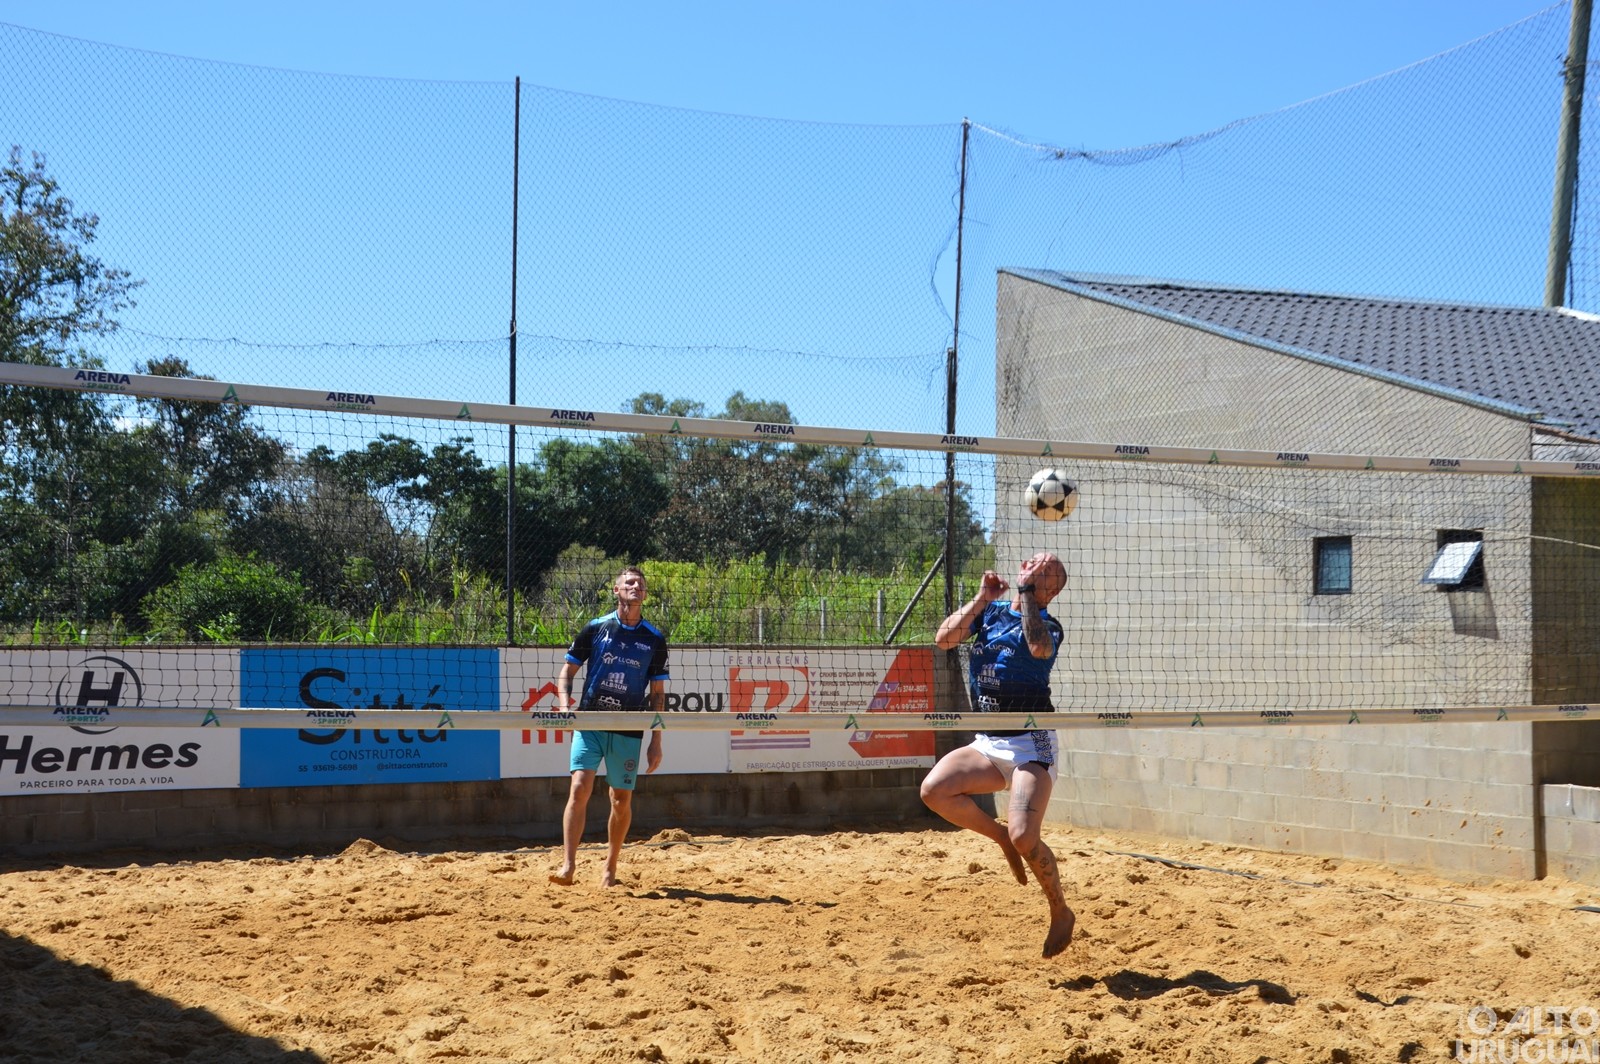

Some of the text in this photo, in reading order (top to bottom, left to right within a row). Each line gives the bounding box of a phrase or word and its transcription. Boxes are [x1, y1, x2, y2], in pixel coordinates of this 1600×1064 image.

[74, 370, 131, 385] ARENA
[325, 391, 376, 405] ARENA
[550, 409, 595, 421] ARENA
[754, 424, 795, 435] ARENA
[941, 435, 979, 446] ARENA
[1114, 445, 1150, 455] ARENA
[1276, 453, 1310, 461] ARENA
[1429, 459, 1461, 467] ARENA
[729, 656, 809, 665] FERRAGENS
[53, 707, 110, 715] ARENA
[306, 710, 357, 718] ARENA
[0, 734, 202, 774] Hermes
[330, 749, 421, 761] CONSTRUTORA
[746, 761, 790, 769] FABRICAÇÃO
[802, 760, 836, 768] ESTRIBOS
[848, 759, 884, 767] QUALQUER
[20, 780, 73, 788] PARCEIRO
[77, 779, 105, 787] PARA
[150, 776, 174, 784] VIDA
